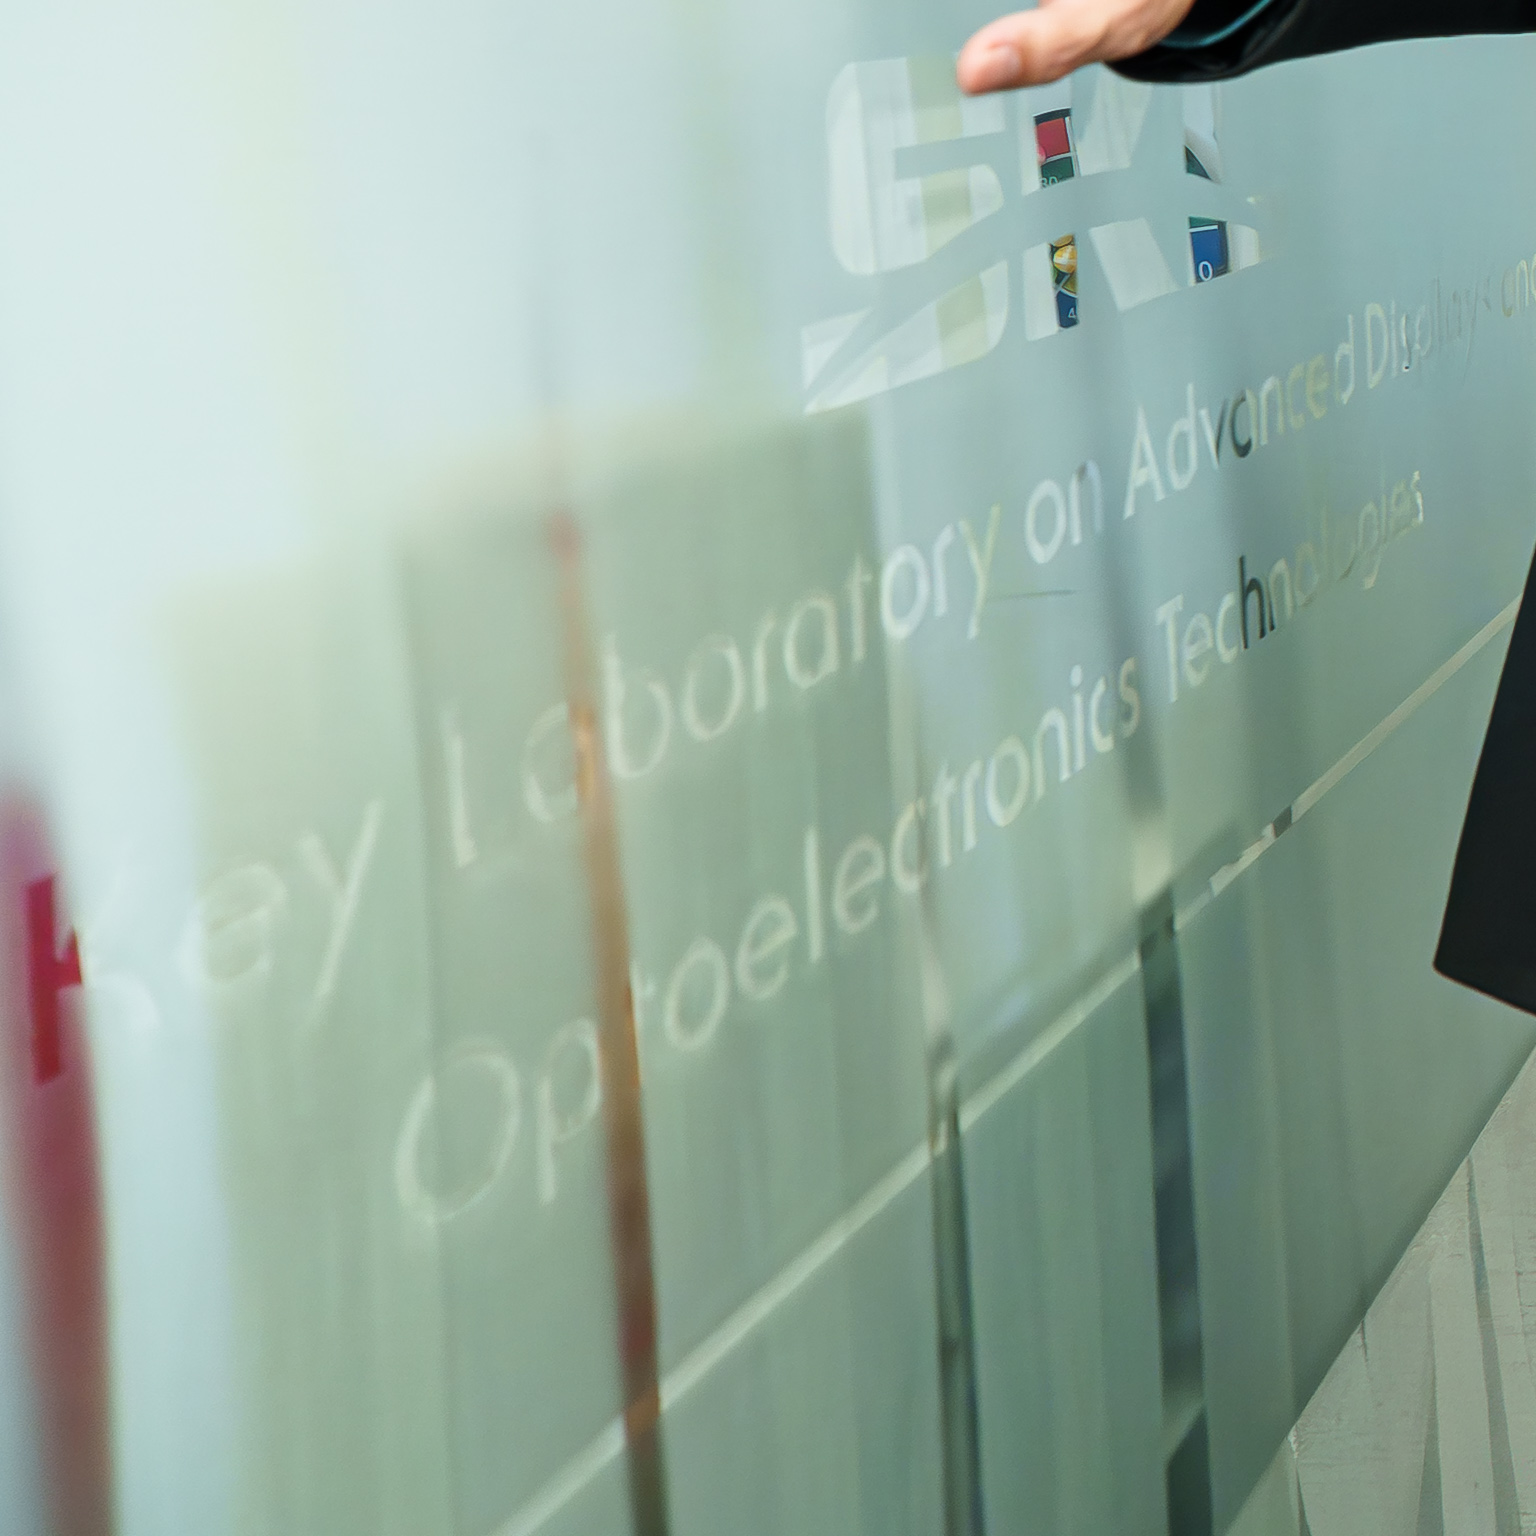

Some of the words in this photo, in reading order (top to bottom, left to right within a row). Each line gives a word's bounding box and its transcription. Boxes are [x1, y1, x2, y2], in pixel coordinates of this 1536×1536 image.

[440, 502, 1000, 869] Laboratory
[1024, 458, 1104, 565] on
[1123, 312, 1357, 521] Advanced
[394, 654, 1142, 1222] Optoelectronics
